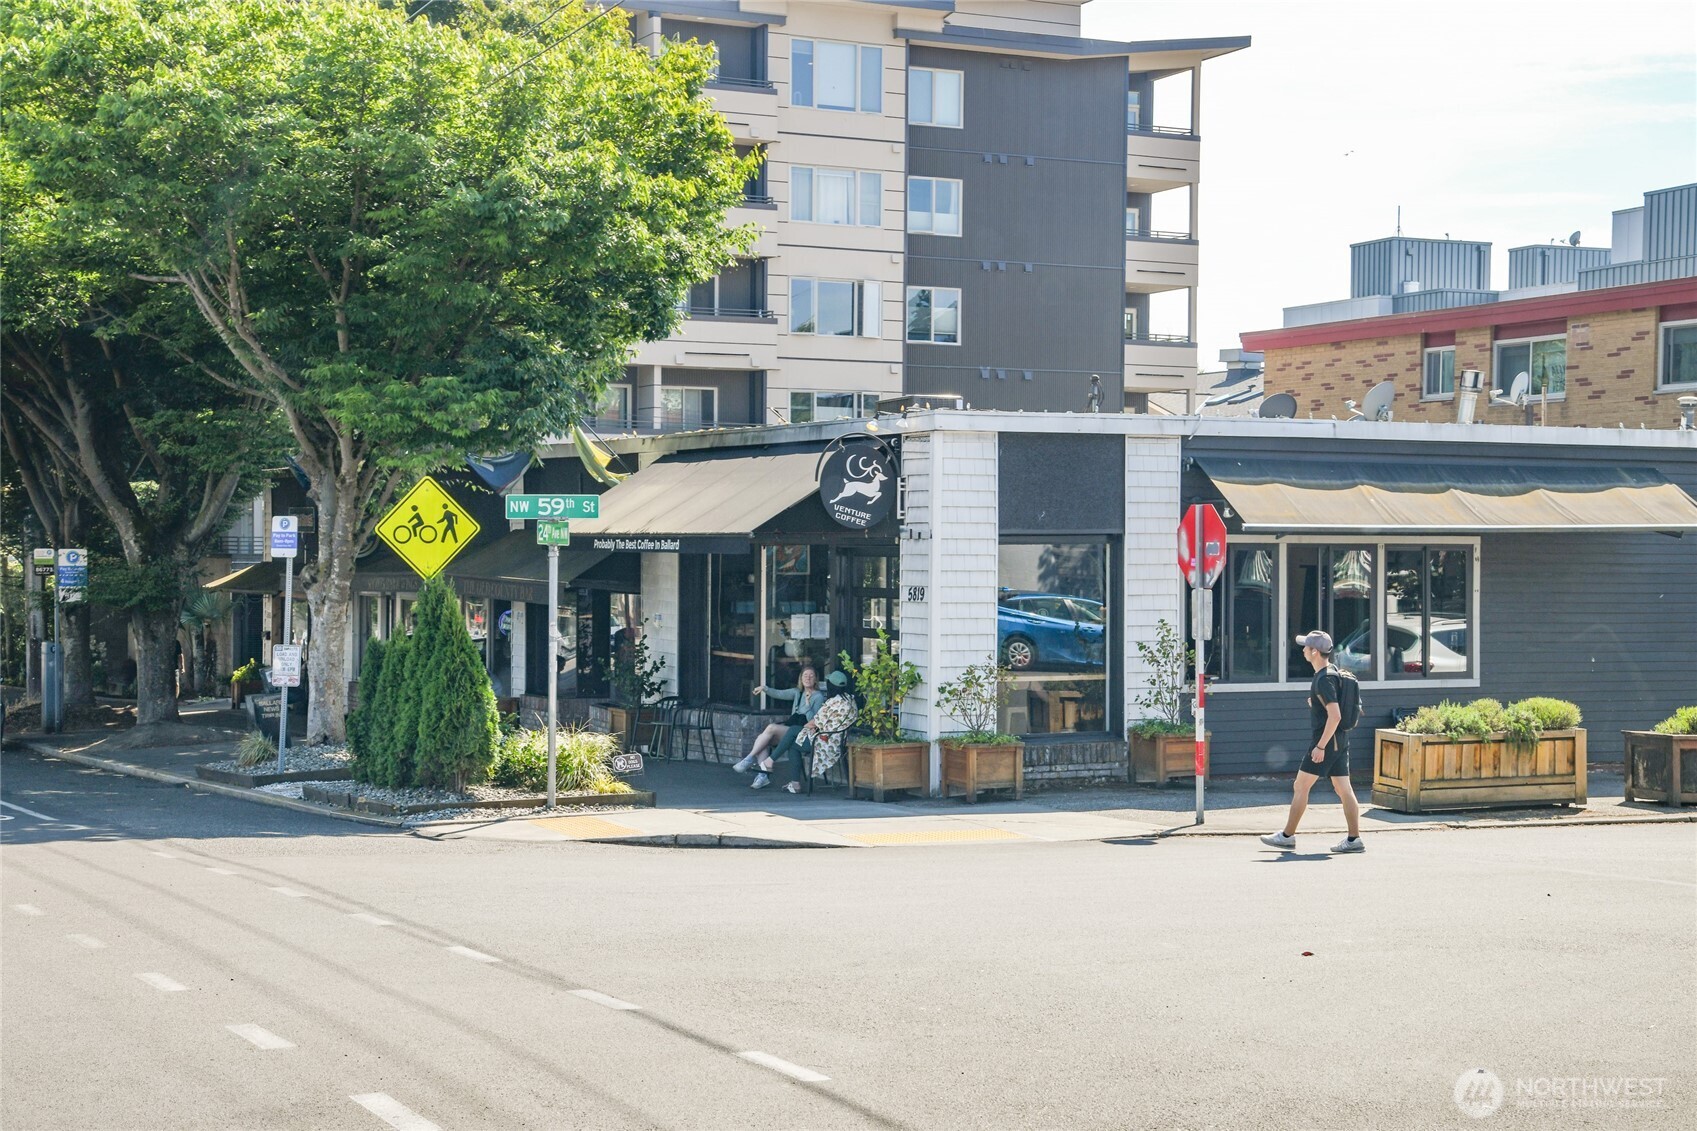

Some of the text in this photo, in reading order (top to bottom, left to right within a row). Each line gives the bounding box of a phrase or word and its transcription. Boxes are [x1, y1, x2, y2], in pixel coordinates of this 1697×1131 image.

[510, 497, 595, 515] NW 59th St
[834, 504, 872, 520] VENTURE
[835, 512, 867, 527] COFFEE
[552, 526, 560, 539] Ave
[561, 527, 568, 539] NW
[593, 539, 680, 551] Probably The Best Coffee In Ballard
[908, 586, 925, 602] 5819
